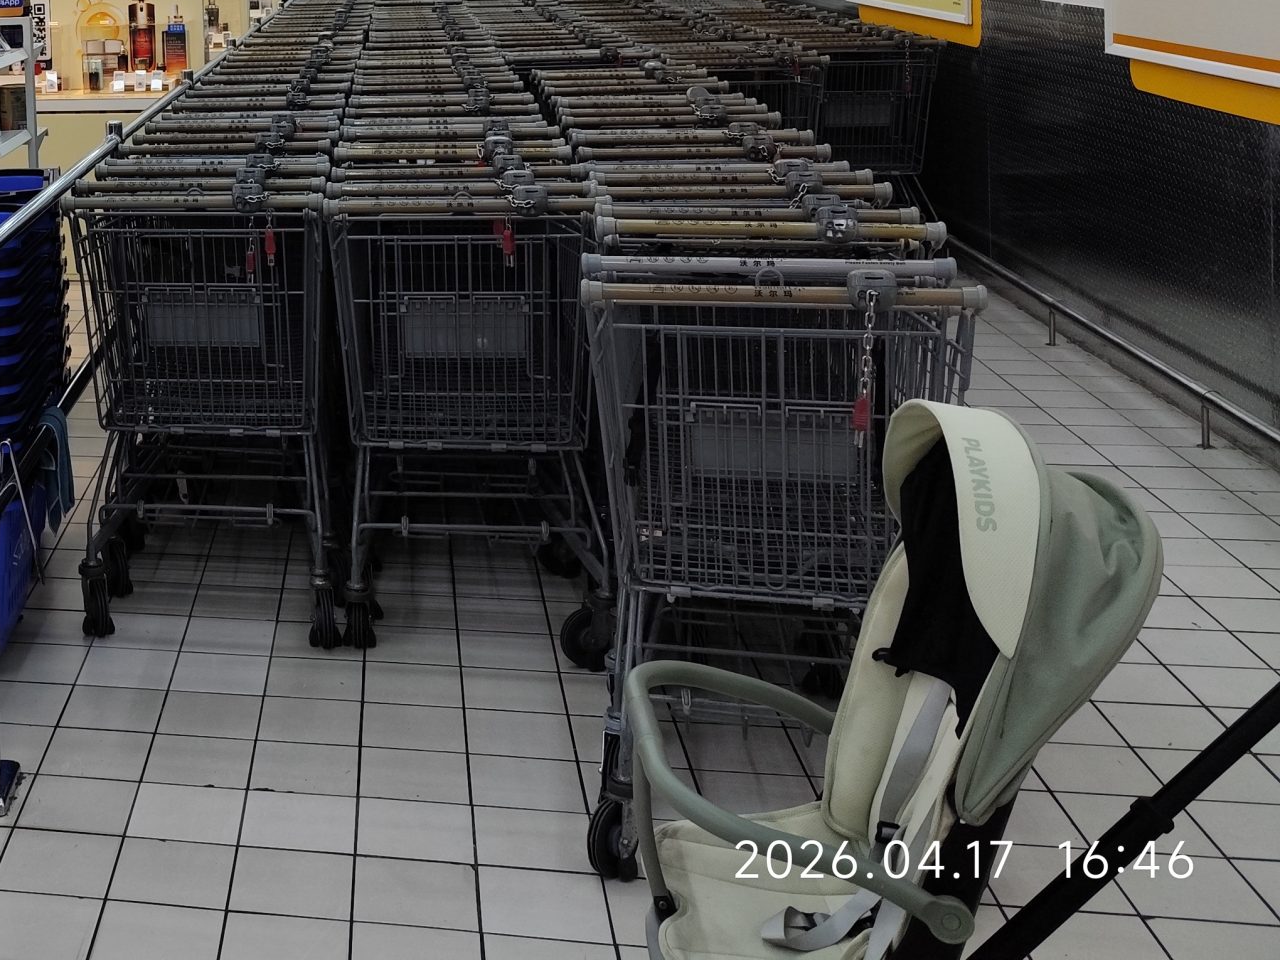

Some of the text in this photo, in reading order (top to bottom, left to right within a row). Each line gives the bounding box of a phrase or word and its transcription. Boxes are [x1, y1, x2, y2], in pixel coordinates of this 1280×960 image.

[739, 259, 776, 267] 沃尔玛
[753, 289, 793, 298] 沃尔玛
[961, 436, 998, 534] PLAYKIDS
